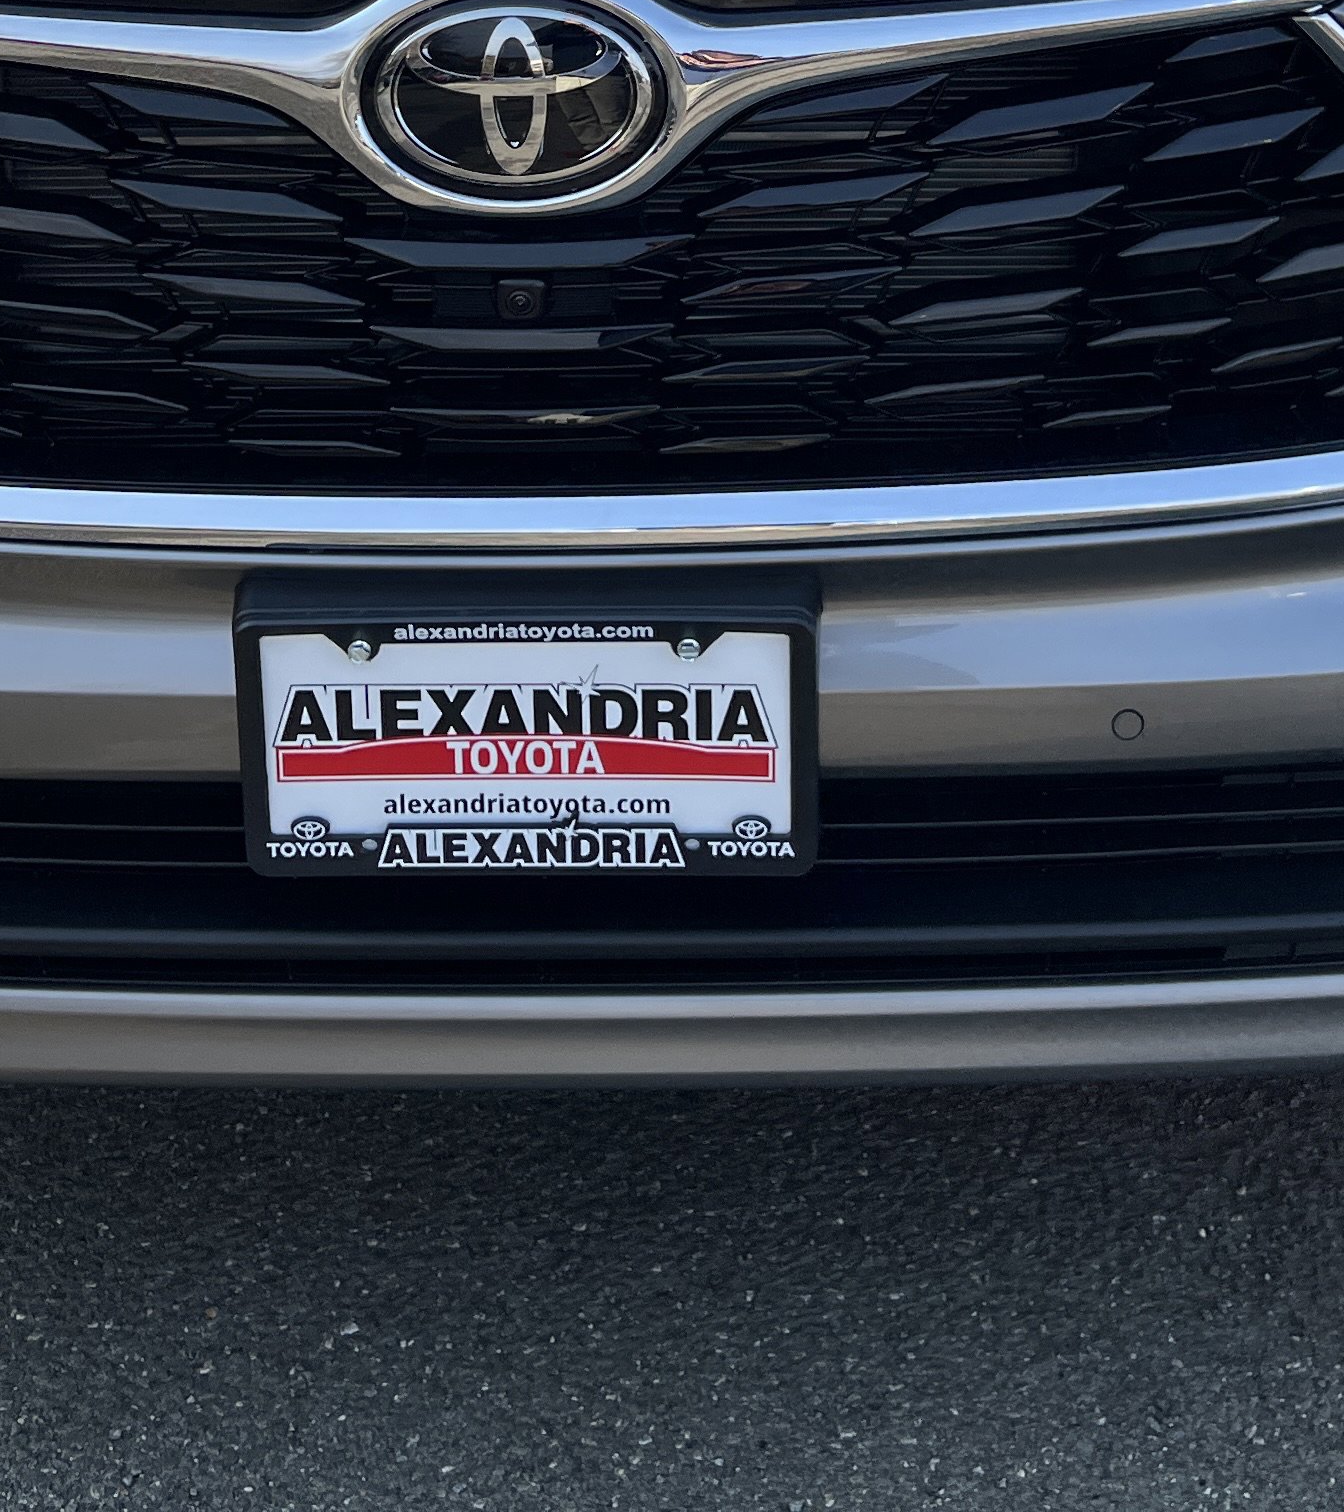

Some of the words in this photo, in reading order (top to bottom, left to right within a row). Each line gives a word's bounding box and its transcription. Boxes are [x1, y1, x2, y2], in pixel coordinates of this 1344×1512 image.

[393, 623, 655, 642] alexandriatoyota.com
[278, 687, 771, 743] ALEXANDRIA
[446, 740, 605, 775] TOYOTA
[383, 793, 671, 819] alexandriatoyota.com
[265, 841, 354, 858] TOYOTA
[378, 828, 686, 868] ALEXANDRIA
[707, 840, 796, 858] TOYOTA
